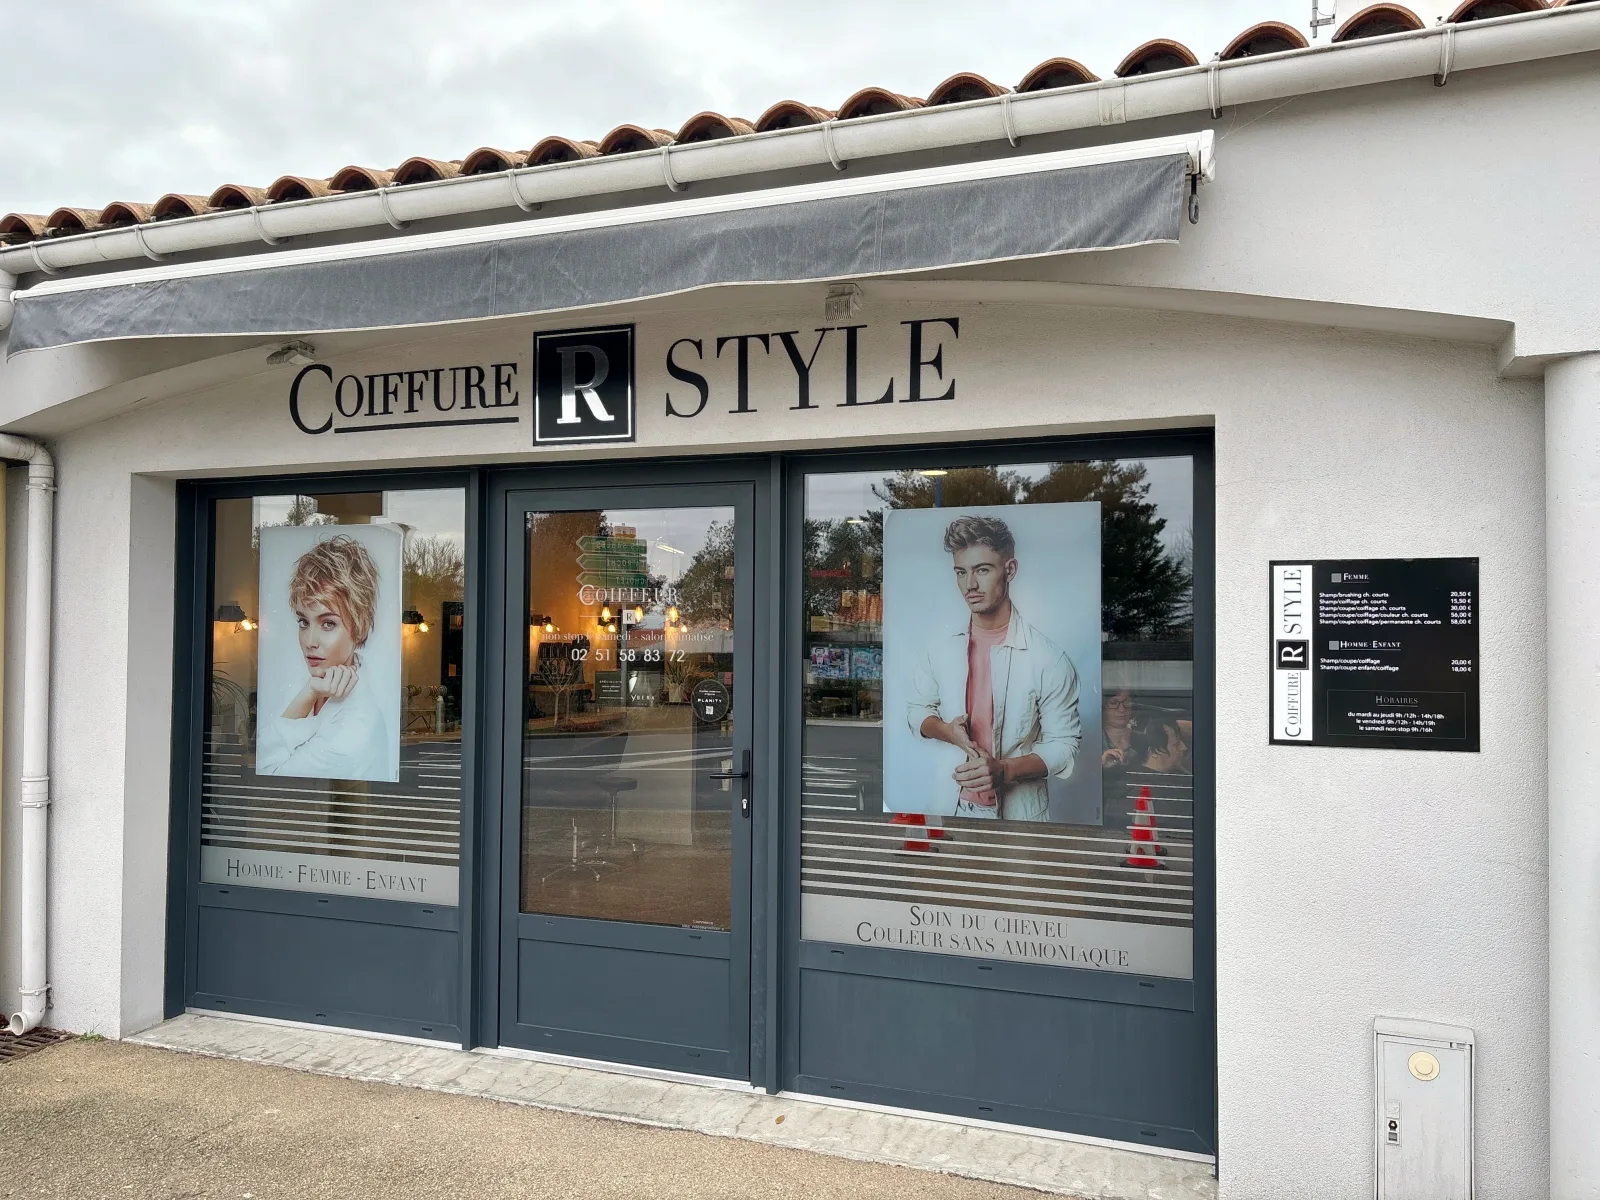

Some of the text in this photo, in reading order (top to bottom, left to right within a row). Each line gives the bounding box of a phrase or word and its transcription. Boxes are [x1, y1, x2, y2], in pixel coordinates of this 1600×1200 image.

[289, 316, 960, 434] COIFFURE R STYLE
[1343, 572, 1369, 581] FEMME
[579, 584, 679, 606] COIFFEUR
[1283, 569, 1303, 634] STYLE
[626, 612, 633, 621] R
[562, 632, 584, 644] stop
[598, 631, 632, 641] samedi
[669, 630, 714, 642] imatisé
[1340, 640, 1369, 648] HOMME
[1372, 640, 1401, 648] ENFANT
[571, 648, 685, 662] 02 51 58 83 72
[1281, 645, 1304, 663] R
[1320, 657, 1381, 665] Shamp/coupe/coiffage
[1284, 672, 1302, 738] COIFFURE
[1375, 695, 1419, 704] HORAIRES
[226, 858, 284, 879] HOMME
[297, 864, 352, 886] FEMME
[365, 870, 427, 893] ENFANT
[909, 905, 1069, 939] SOIN DU CHEVEU
[856, 921, 1130, 968] COULEUR SANS AMMONIAQUE
